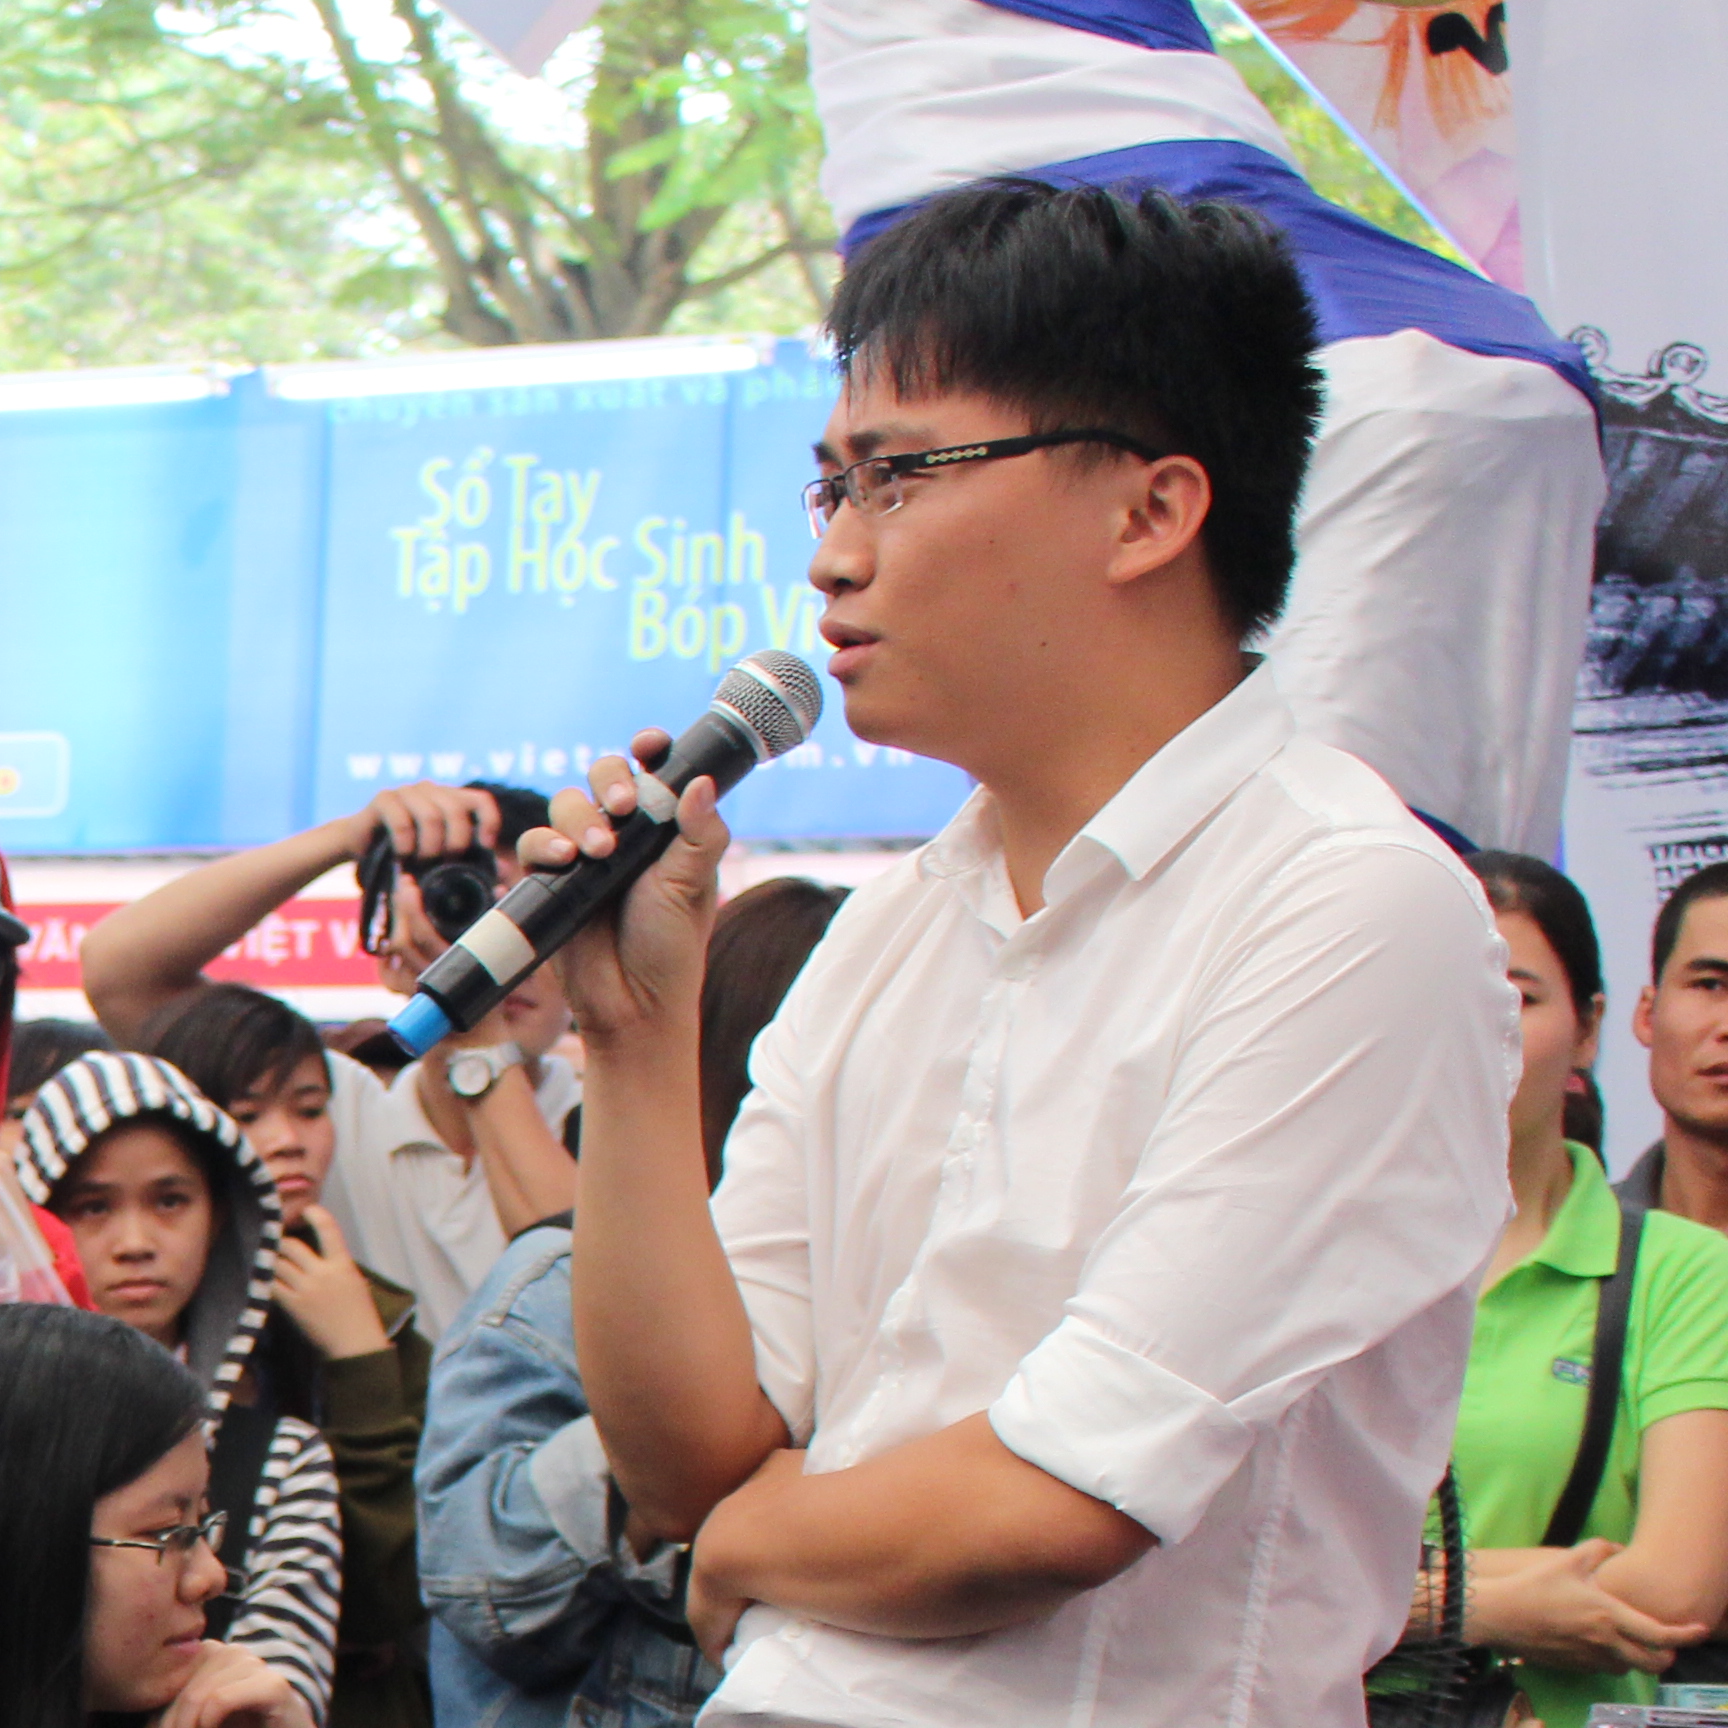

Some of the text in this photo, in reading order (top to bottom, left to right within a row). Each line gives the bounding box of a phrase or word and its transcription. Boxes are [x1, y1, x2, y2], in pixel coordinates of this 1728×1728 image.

[418, 446, 602, 540] Sổ Tay
[390, 512, 766, 614] Tập Học Sinh
[630, 585, 746, 670] Bóp
